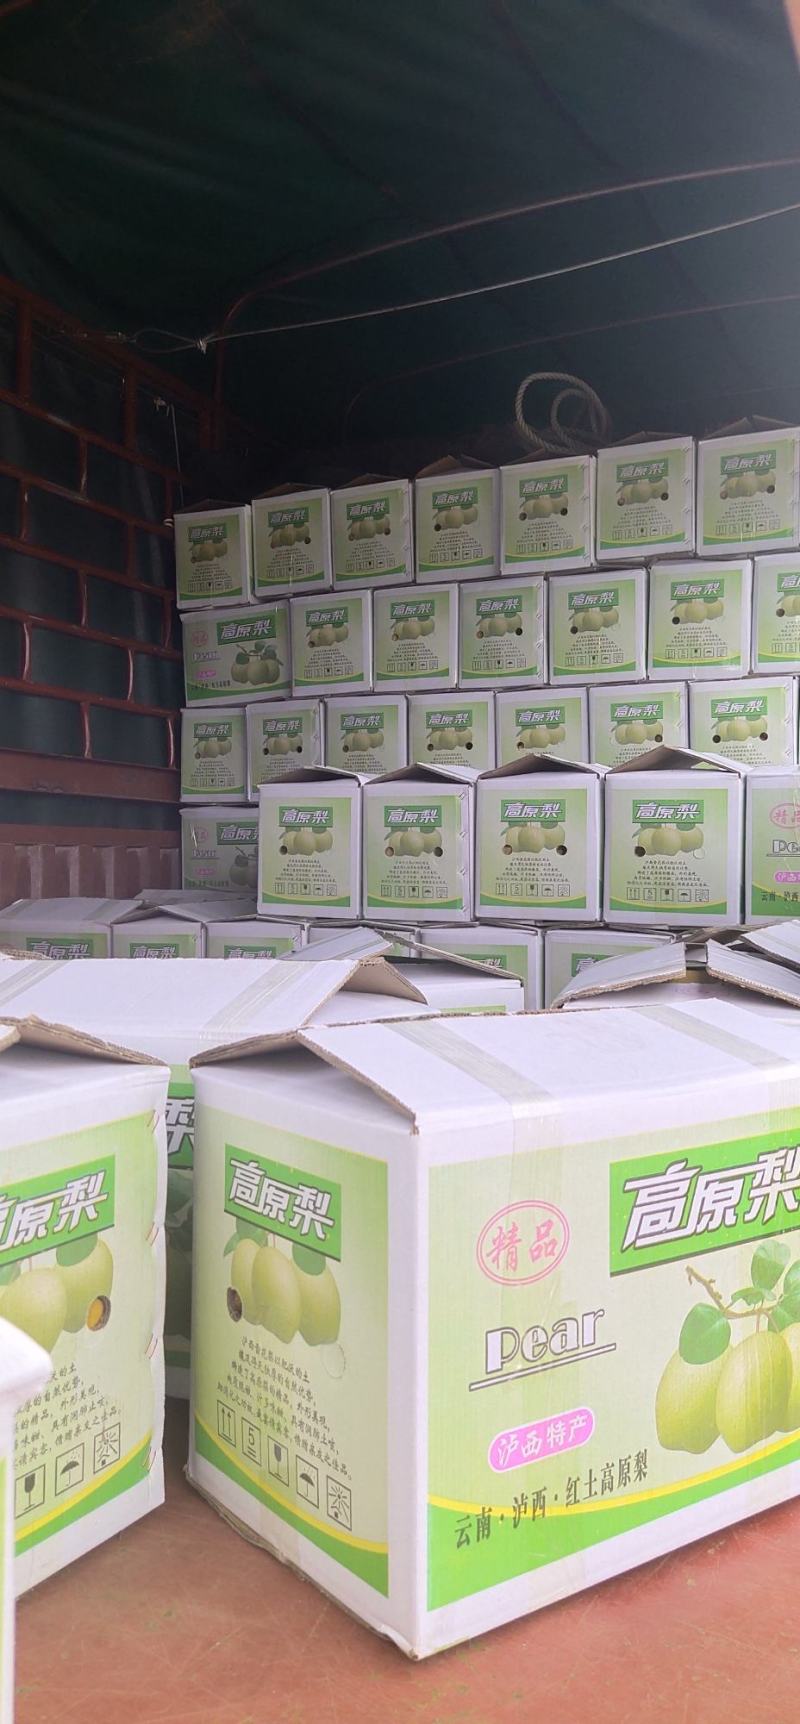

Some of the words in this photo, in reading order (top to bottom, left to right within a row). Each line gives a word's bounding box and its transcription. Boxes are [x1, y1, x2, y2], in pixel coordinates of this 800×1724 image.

[619, 461, 666, 478] 高原梨
[723, 453, 773, 471] 高原梨
[522, 477, 564, 495] 高原梨
[434, 489, 474, 505] 高原梨
[269, 508, 306, 525] 高原梨
[348, 500, 386, 517] 高原梨
[188, 524, 224, 540] 高原梨
[673, 580, 721, 597] 高原梨
[782, 574, 800, 589] 高
[478, 597, 520, 612] 高原梨
[570, 589, 616, 606] 高原梨
[308, 608, 346, 624] 高原梨
[391, 601, 433, 618] 高原梨
[220, 619, 273, 640] 高原梨
[613, 702, 661, 719] 高原梨
[714, 697, 766, 715] 高原梨
[342, 712, 380, 728] 高原梨
[428, 711, 470, 726] 高原梨
[518, 708, 561, 724] 高原梨
[195, 722, 230, 738] 高原梨
[264, 719, 301, 734] 高原梨
[281, 808, 330, 825] 高原梨
[387, 807, 440, 825] 高原梨
[503, 801, 563, 819] 高原梨
[635, 801, 701, 820] 高原梨
[220, 824, 259, 842] 高原
[772, 839, 800, 854] Pe
[230, 1158, 336, 1241] 高原梨
[621, 1143, 800, 1252] 高原梨
[486, 1218, 560, 1272] 精品
[485, 1308, 606, 1375] Pear
[496, 1413, 589, 1467] 泸西特产
